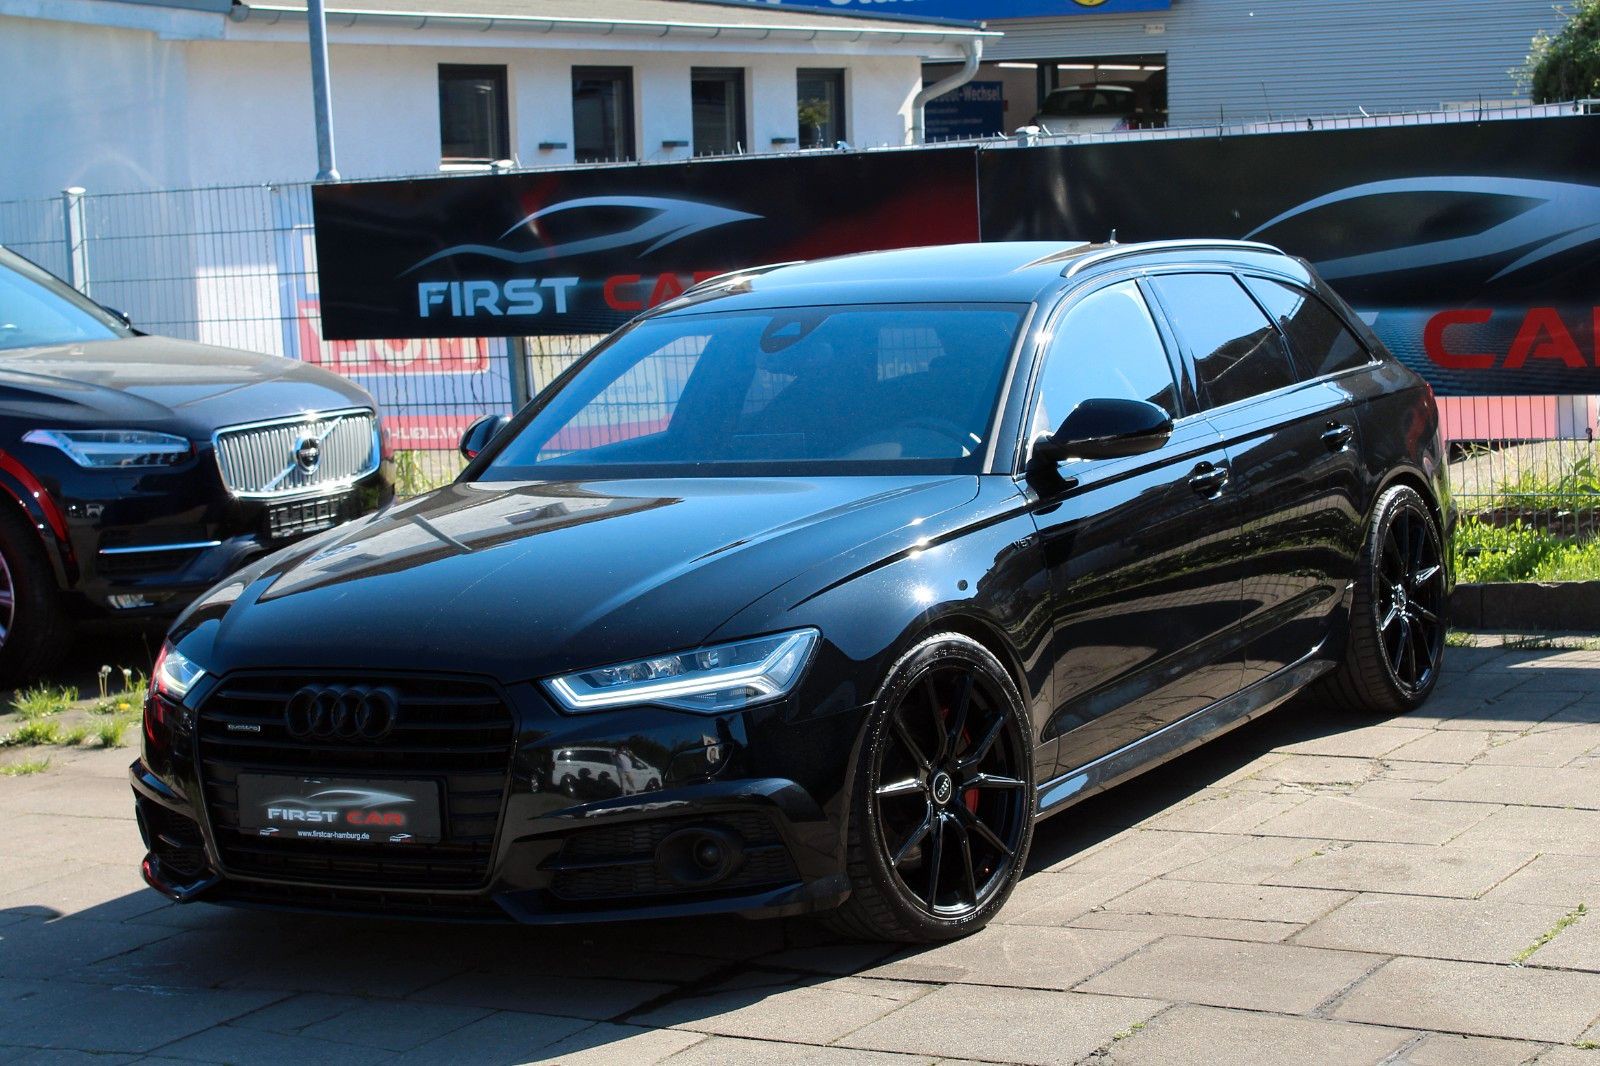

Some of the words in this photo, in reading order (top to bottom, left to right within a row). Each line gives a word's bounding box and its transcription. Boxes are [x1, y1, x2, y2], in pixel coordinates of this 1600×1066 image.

[418, 276, 580, 318] FIRST
[1423, 306, 1600, 369] CA
[267, 807, 338, 823] FIRST
[346, 811, 403, 825] CAR
[297, 830, 370, 841] www.firstcar-hamburg.de
